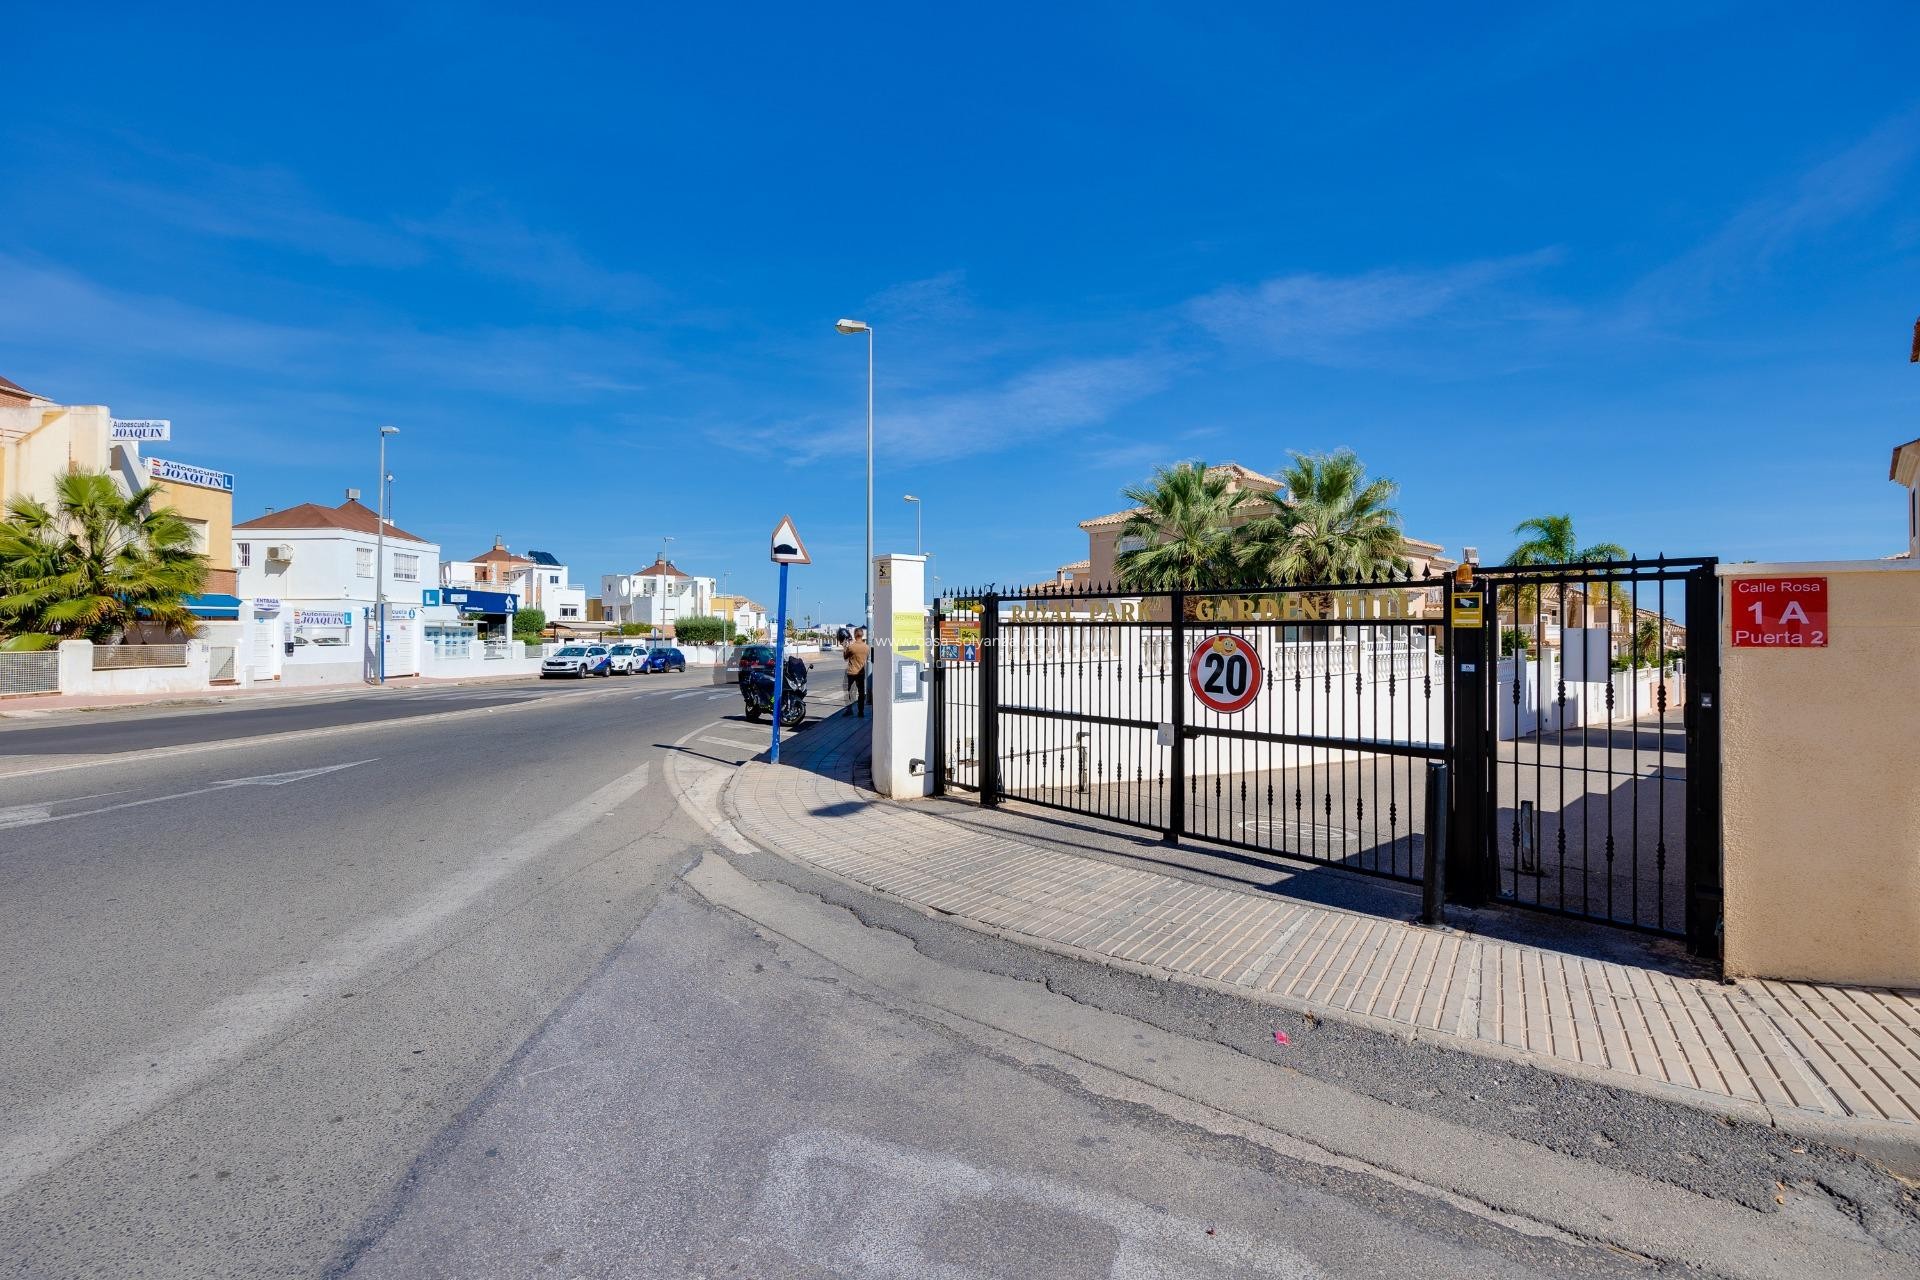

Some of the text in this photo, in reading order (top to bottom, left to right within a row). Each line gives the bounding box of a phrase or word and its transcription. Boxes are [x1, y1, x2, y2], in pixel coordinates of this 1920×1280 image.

[112, 428, 163, 438] JOAQUIN
[162, 461, 223, 479] Autoescuela
[162, 468, 222, 487] JOAQUIN
[1738, 582, 1820, 593] Calle Rosa
[425, 592, 435, 605] L
[1011, 598, 1151, 622] ROYAL PARK
[1196, 596, 1320, 621] GARDEN
[1747, 601, 1810, 625] 1 A
[301, 616, 343, 625] JOAQUIN
[1735, 630, 1824, 644] Puerta 2
[1204, 653, 1247, 697] 20
